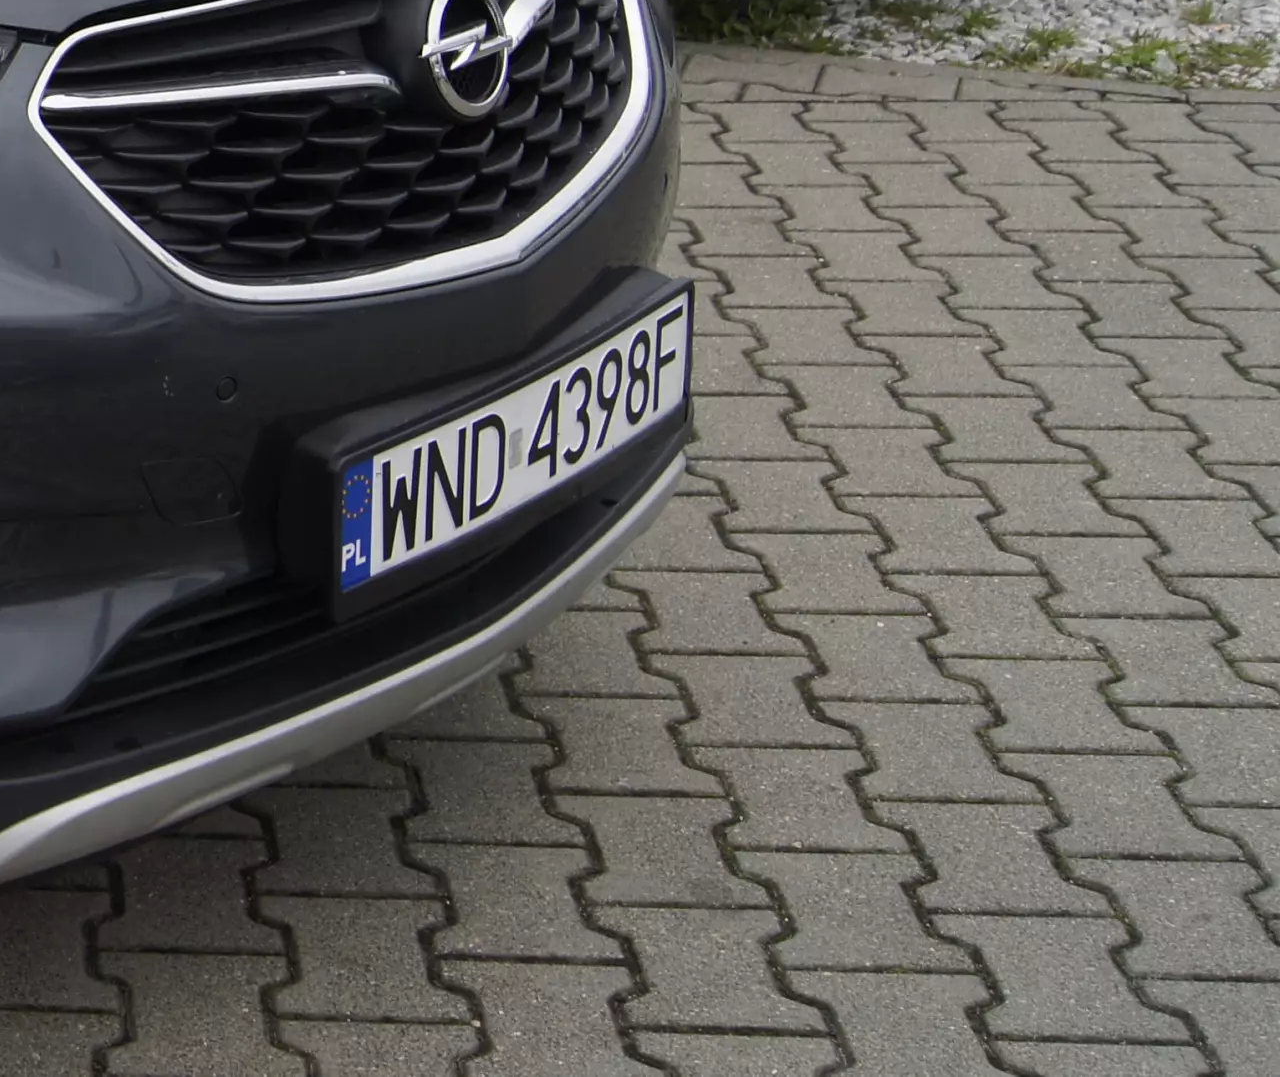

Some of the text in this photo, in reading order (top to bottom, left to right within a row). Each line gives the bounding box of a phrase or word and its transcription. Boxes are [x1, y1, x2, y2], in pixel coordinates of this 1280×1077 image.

[380, 305, 684, 562] WND 4398F
[341, 542, 367, 573] PL
